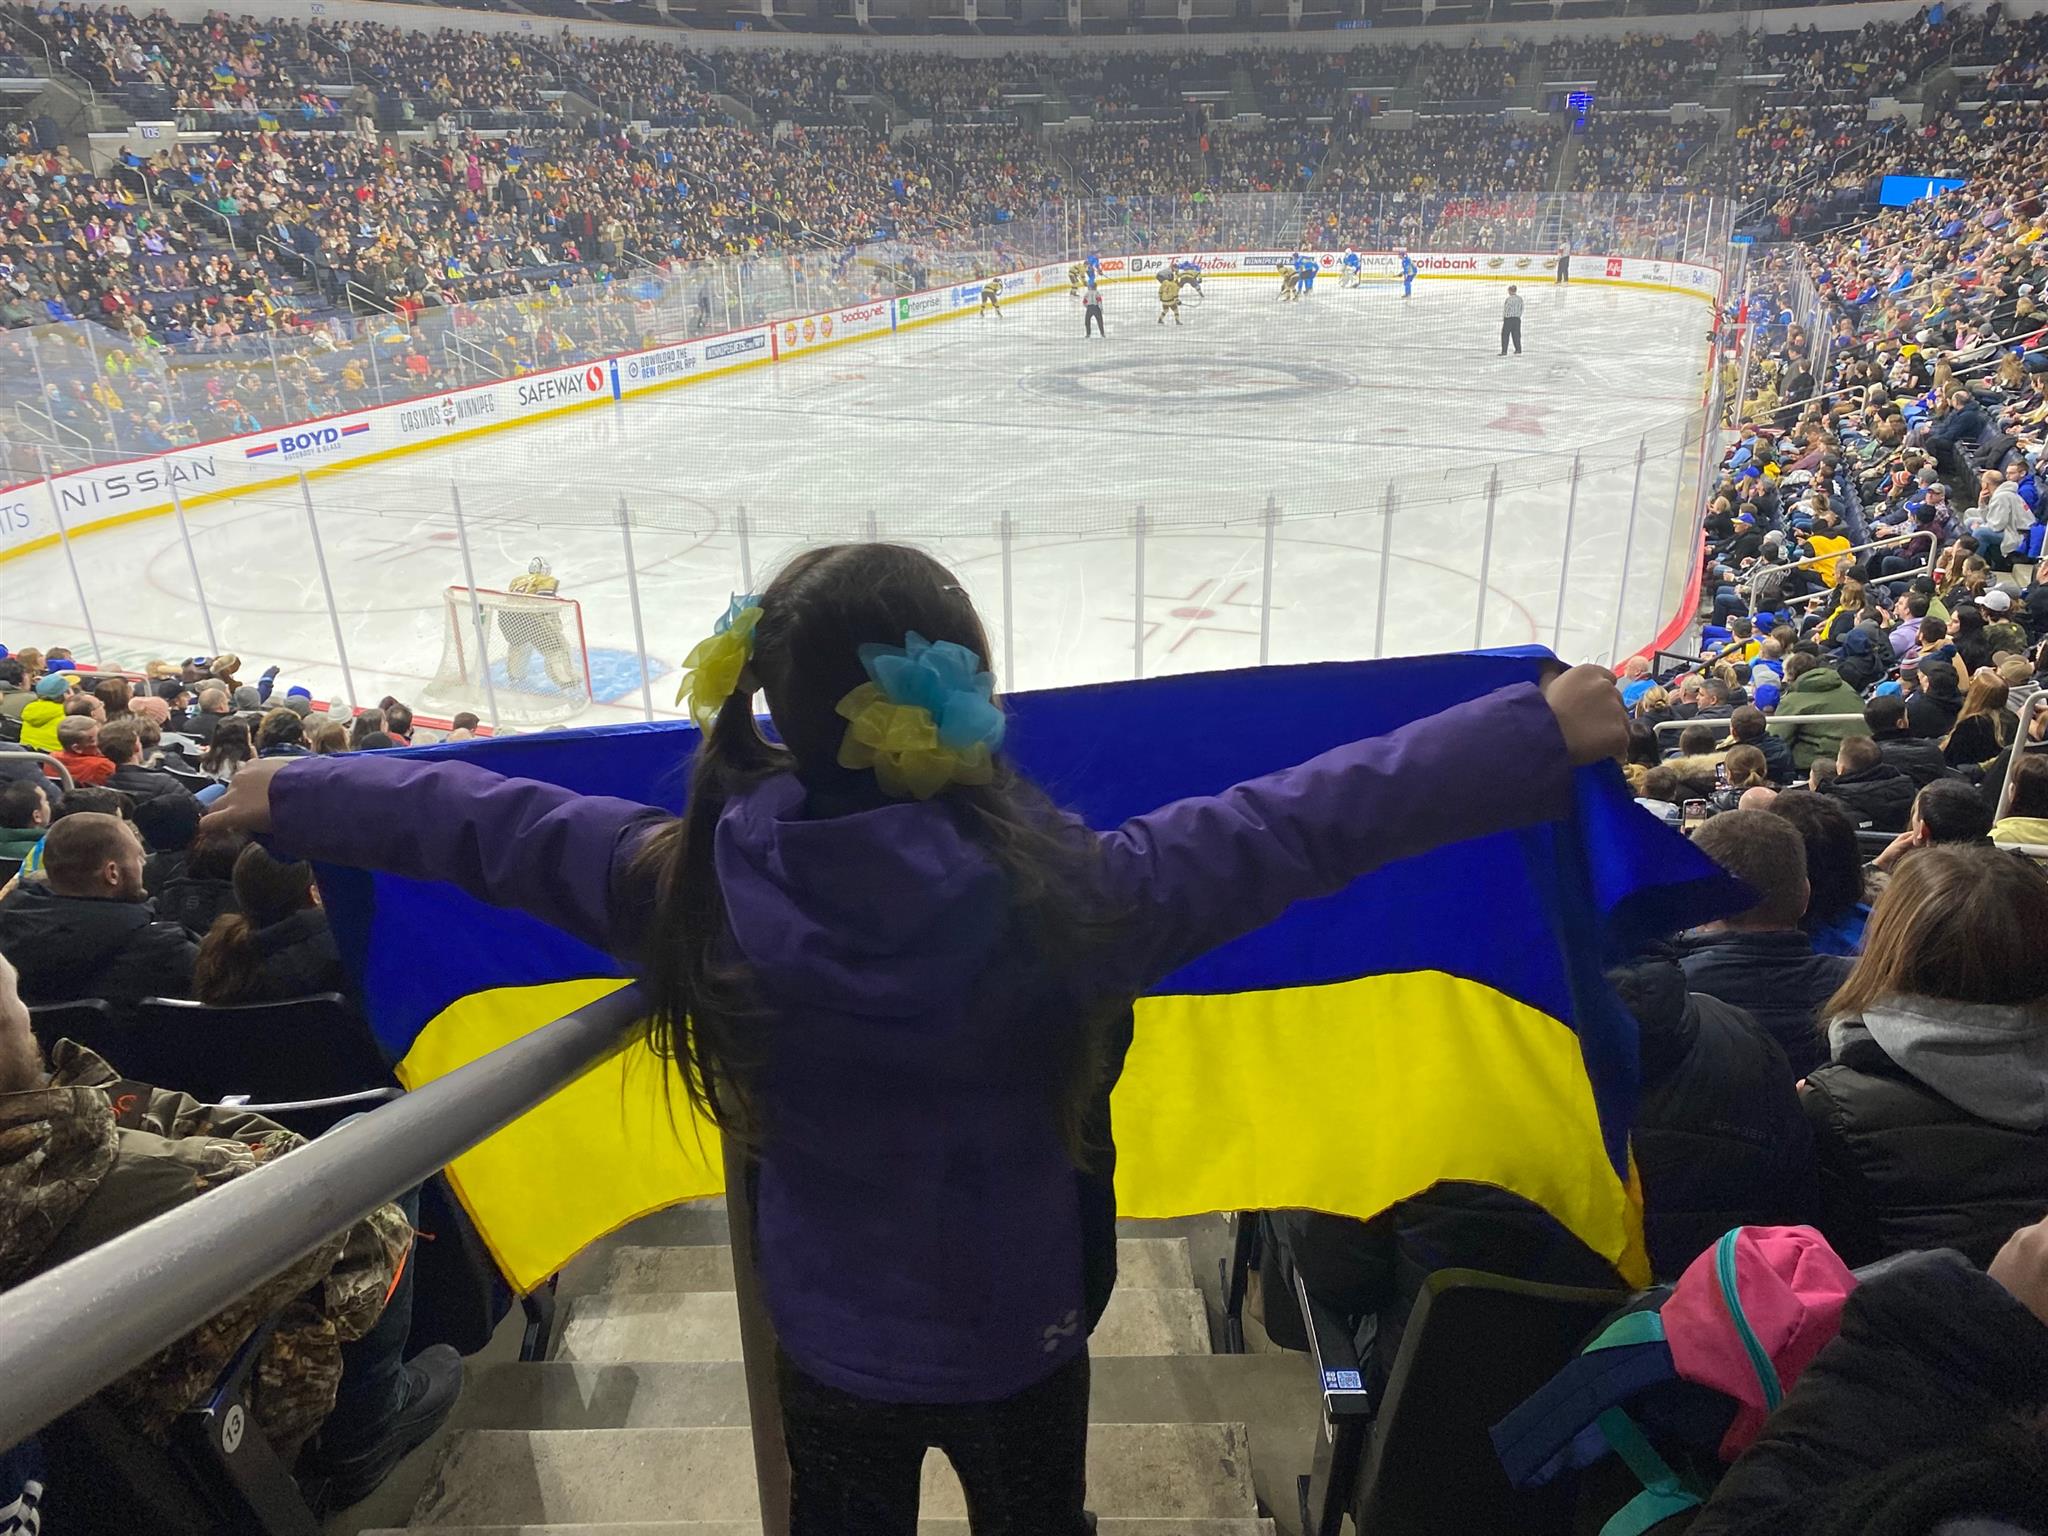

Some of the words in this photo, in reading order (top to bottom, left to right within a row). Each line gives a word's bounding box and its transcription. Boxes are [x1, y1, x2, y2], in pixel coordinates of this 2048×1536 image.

[142, 127, 160, 138] 105
[902, 298, 941, 313] enterprise
[641, 351, 675, 367] DOWNLOAD
[677, 348, 687, 359] THE
[519, 373, 583, 405] SAFEWAY
[401, 406, 440, 432] CASINOS
[443, 408, 453, 416] OF
[455, 394, 494, 418] WINNIPEG
[280, 428, 338, 453] BOYD
[62, 457, 216, 511] NISSAN
[0, 503, 30, 534] TS
